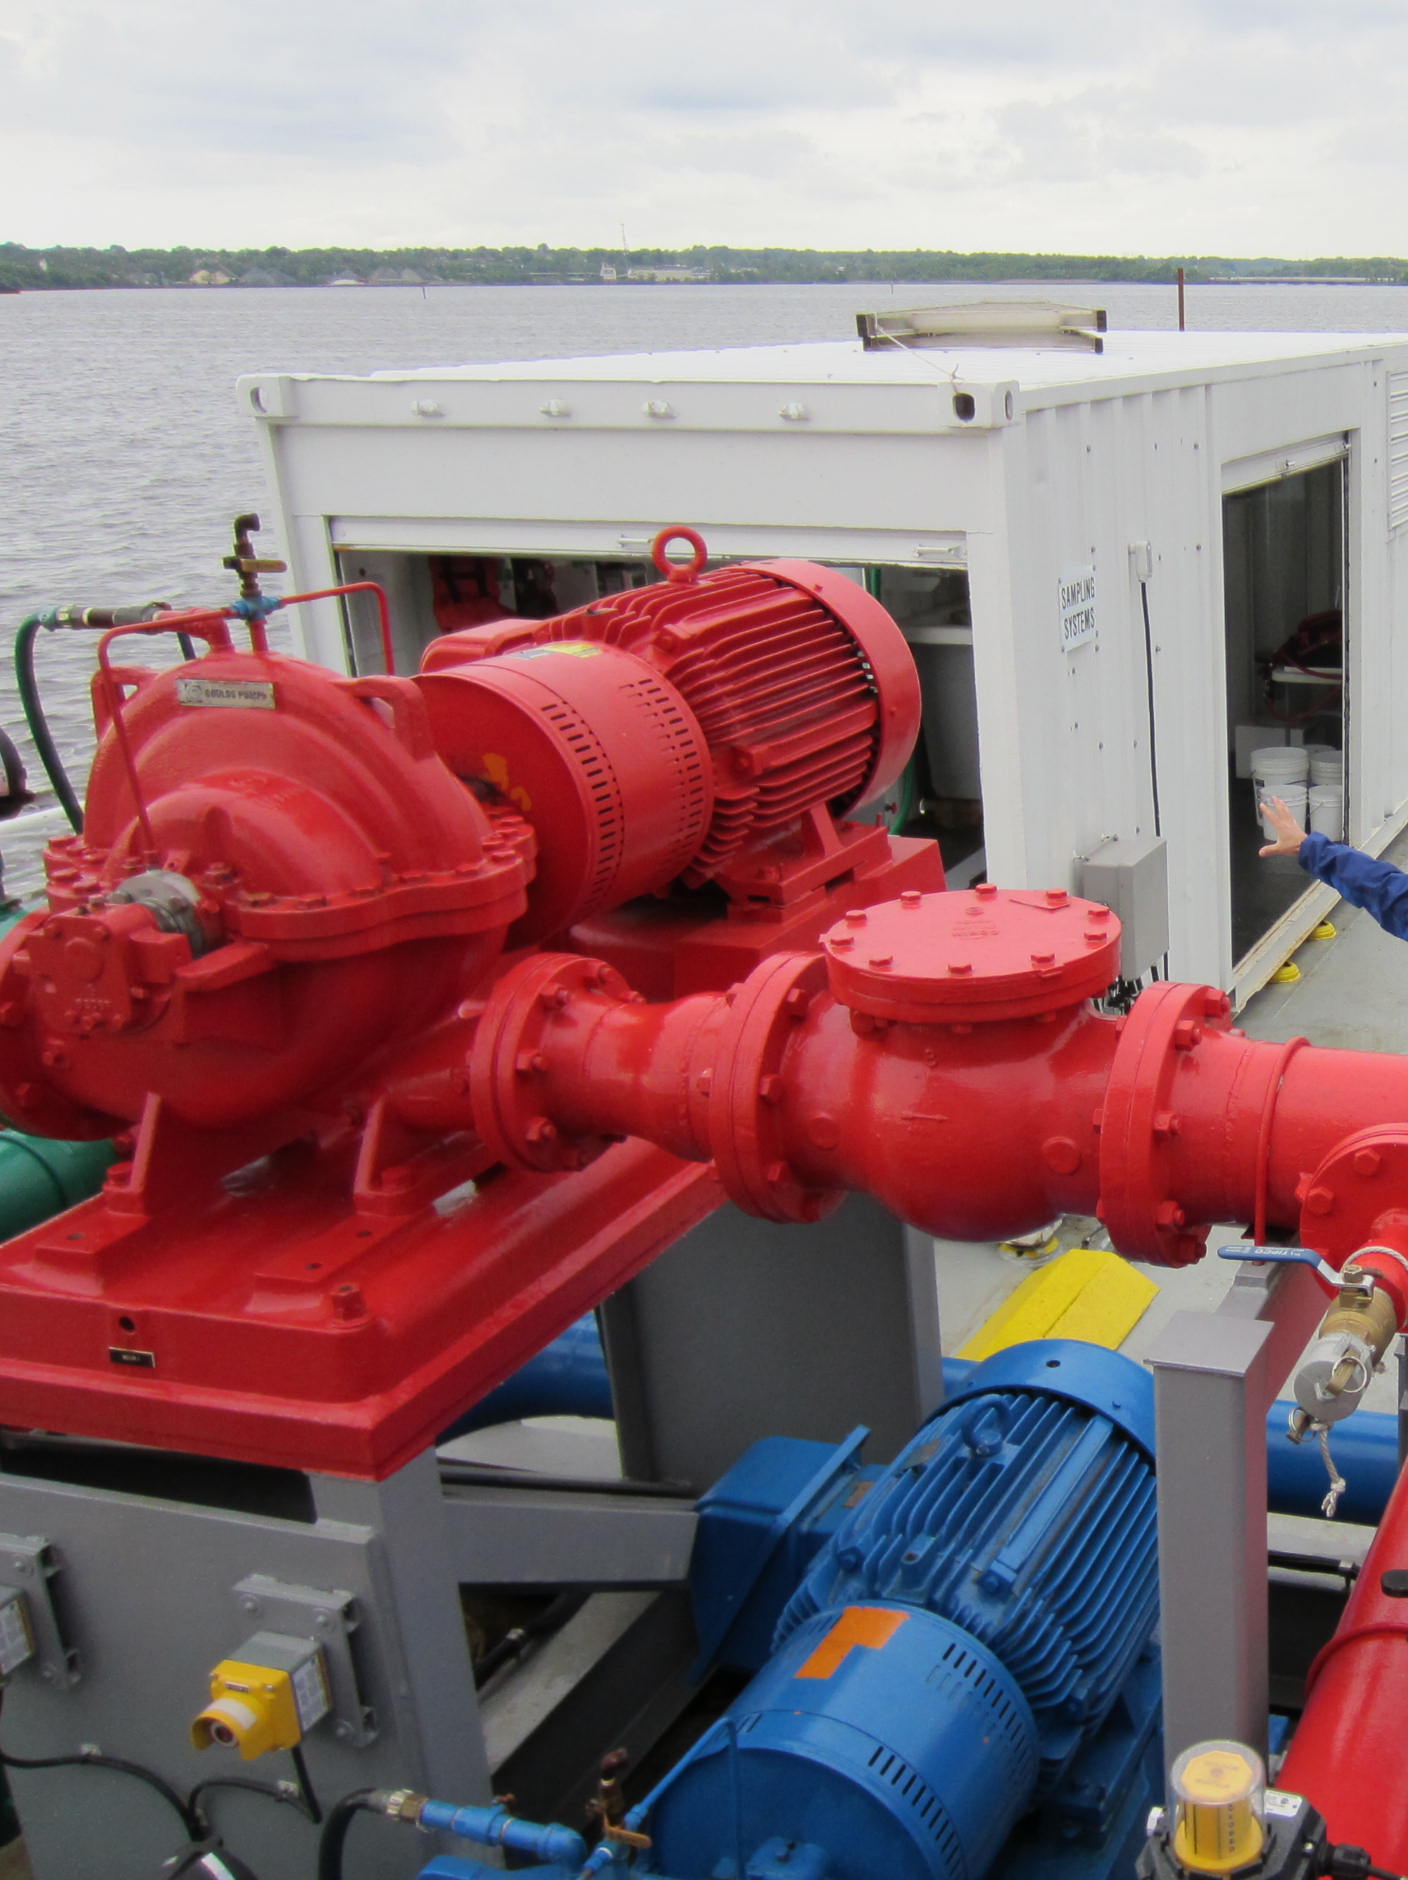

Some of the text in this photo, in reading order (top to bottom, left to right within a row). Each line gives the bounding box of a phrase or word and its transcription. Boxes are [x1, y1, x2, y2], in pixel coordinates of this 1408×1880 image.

[1061, 577, 1095, 609] SAMPLING
[1064, 607, 1095, 640] SYSTEMS
[204, 689, 236, 698] GOULDS
